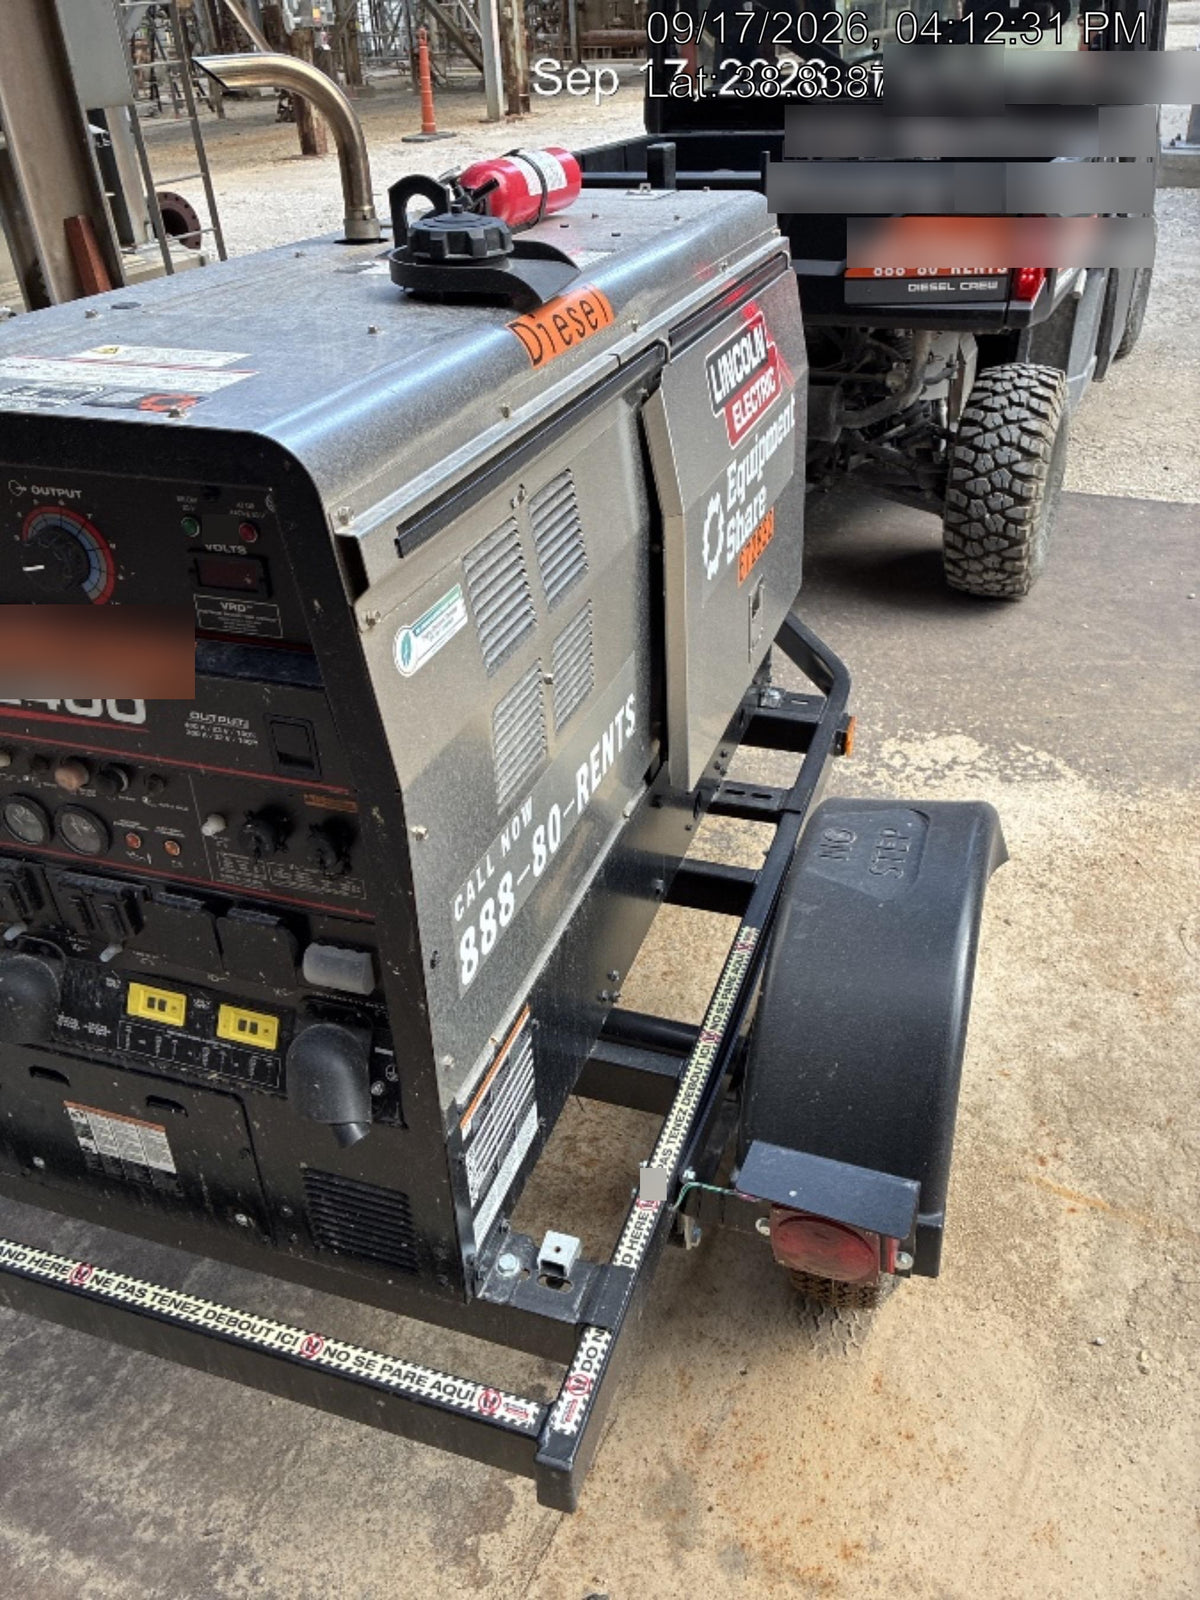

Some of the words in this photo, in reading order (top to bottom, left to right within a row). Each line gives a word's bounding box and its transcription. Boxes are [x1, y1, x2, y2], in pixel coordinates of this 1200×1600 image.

[959, 280, 999, 291] CREW
[710, 323, 767, 404] LINCOLN
[732, 365, 776, 433] ELECTRIC
[30, 484, 82, 499] OUTPUT
[726, 393, 796, 512] Equipment
[204, 543, 248, 556] VOLTS
[726, 485, 767, 565] Share
[453, 854, 495, 922] CALL
[500, 795, 534, 857] NOW
[459, 692, 637, 986] 888-80-RENTS
[665, 1107, 689, 1145] TENEZ
[681, 1060, 704, 1106] DEBOUT
[626, 1211, 650, 1251] HERE
[27, 1255, 71, 1275] HERE
[90, 1274, 113, 1287] NE
[115, 1280, 148, 1299] PAS
[151, 1291, 201, 1317] TENEZ
[203, 1308, 274, 1338] DEBOUT
[275, 1329, 300, 1347] ICI
[322, 1345, 351, 1363] NO
[352, 1355, 379, 1372] SE
[379, 1363, 430, 1387] PARE
[580, 1346, 598, 1373] DO
